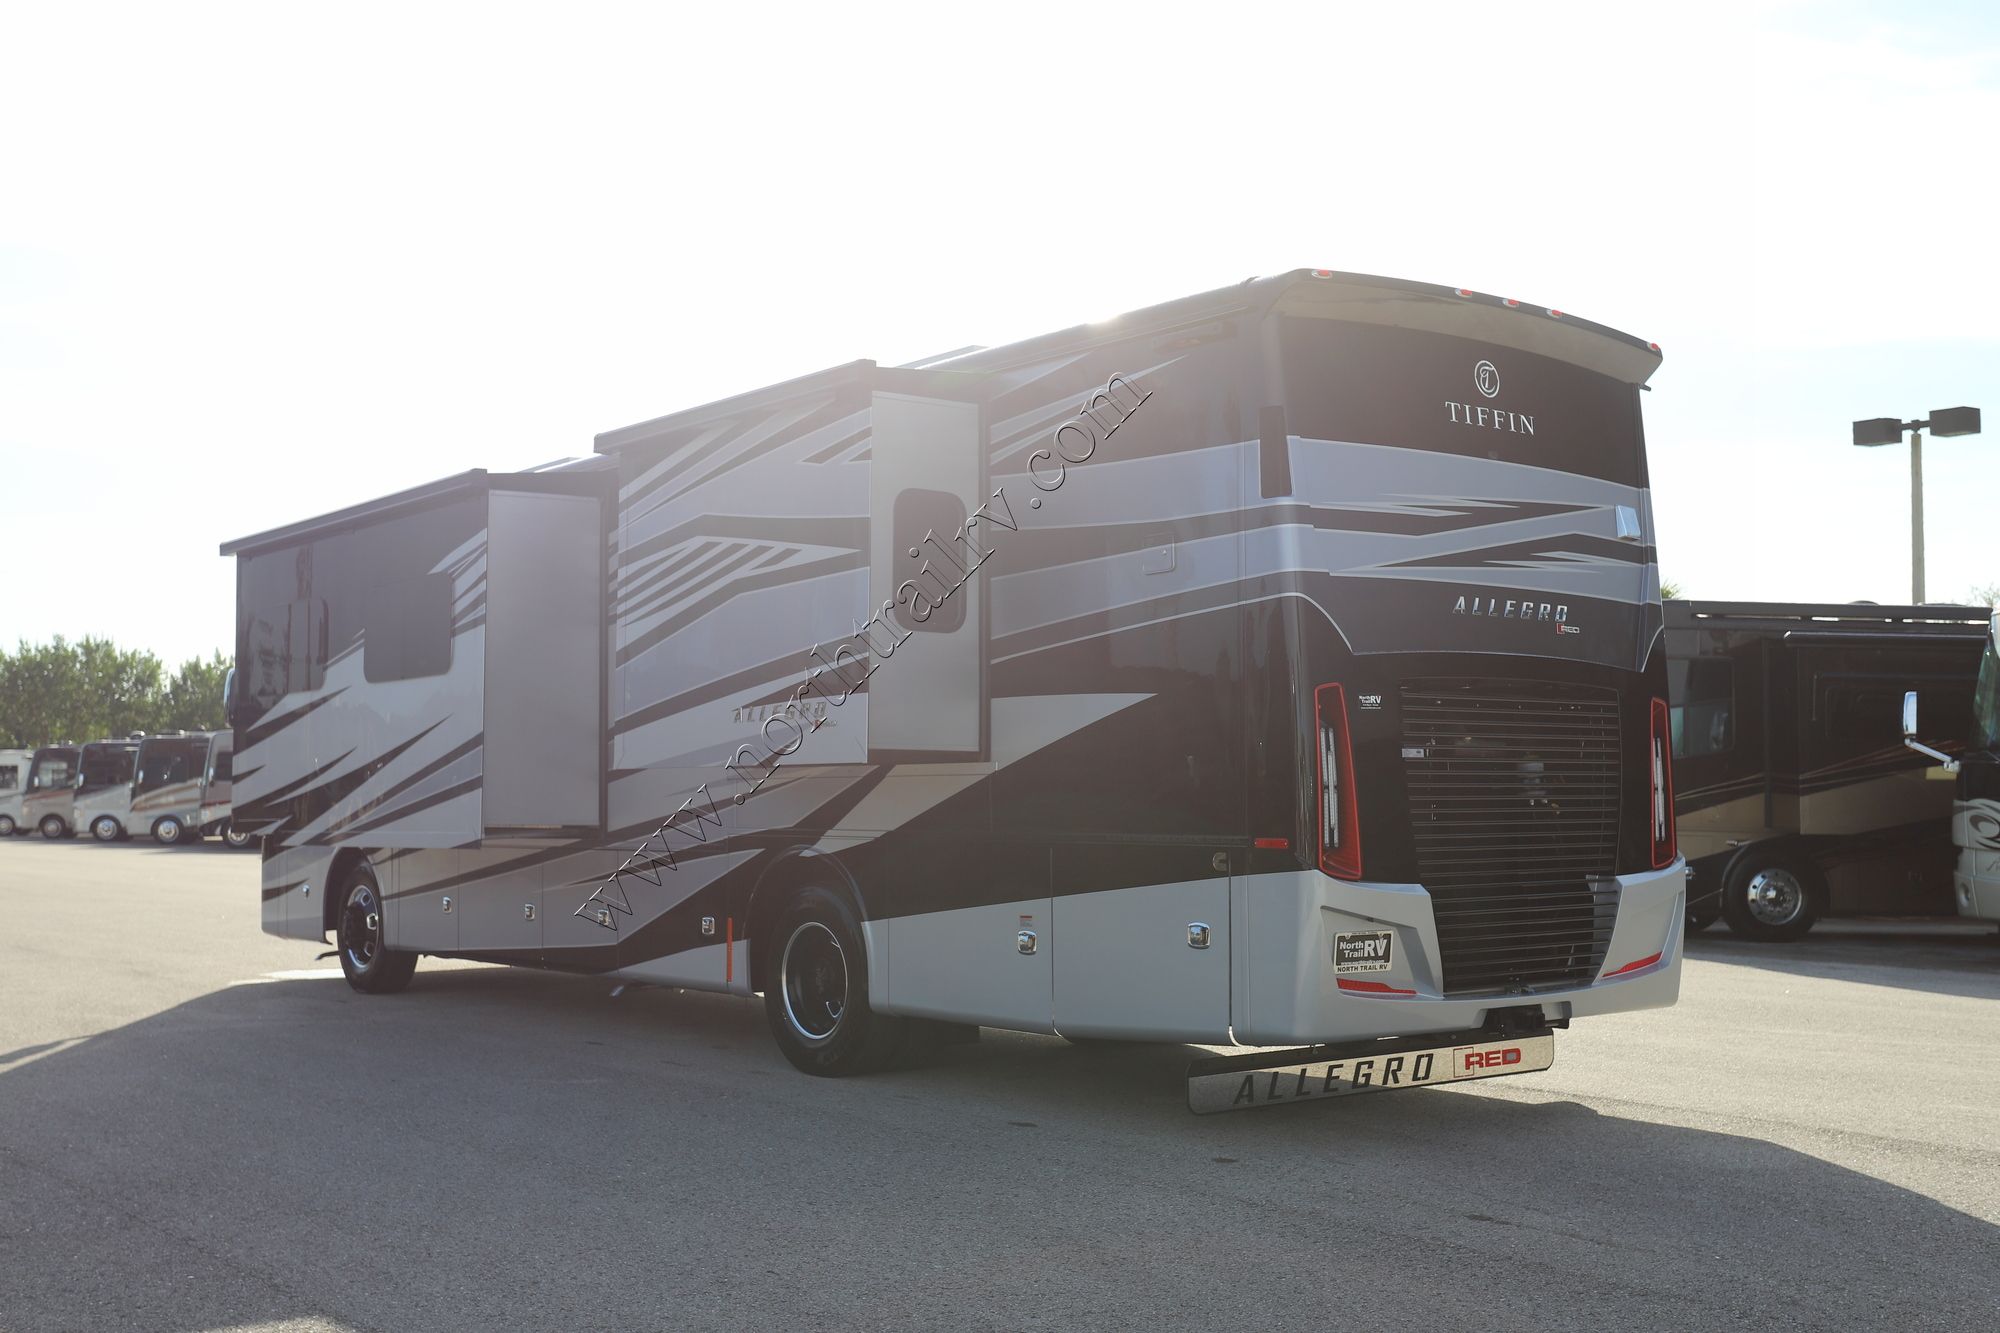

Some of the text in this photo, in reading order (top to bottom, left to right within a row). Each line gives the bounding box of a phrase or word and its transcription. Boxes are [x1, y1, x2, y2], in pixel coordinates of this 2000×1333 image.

[1444, 401, 1535, 436] TIFFIN
[1452, 595, 1568, 623] ALLEGRO
[1370, 695, 1382, 704] RV
[1339, 941, 1364, 950] North
[1364, 939, 1388, 957] RV
[1343, 950, 1364, 958] Trail
[1337, 965, 1359, 973] NORTH
[1233, 1047, 1521, 1105] ALLEGRO RED
